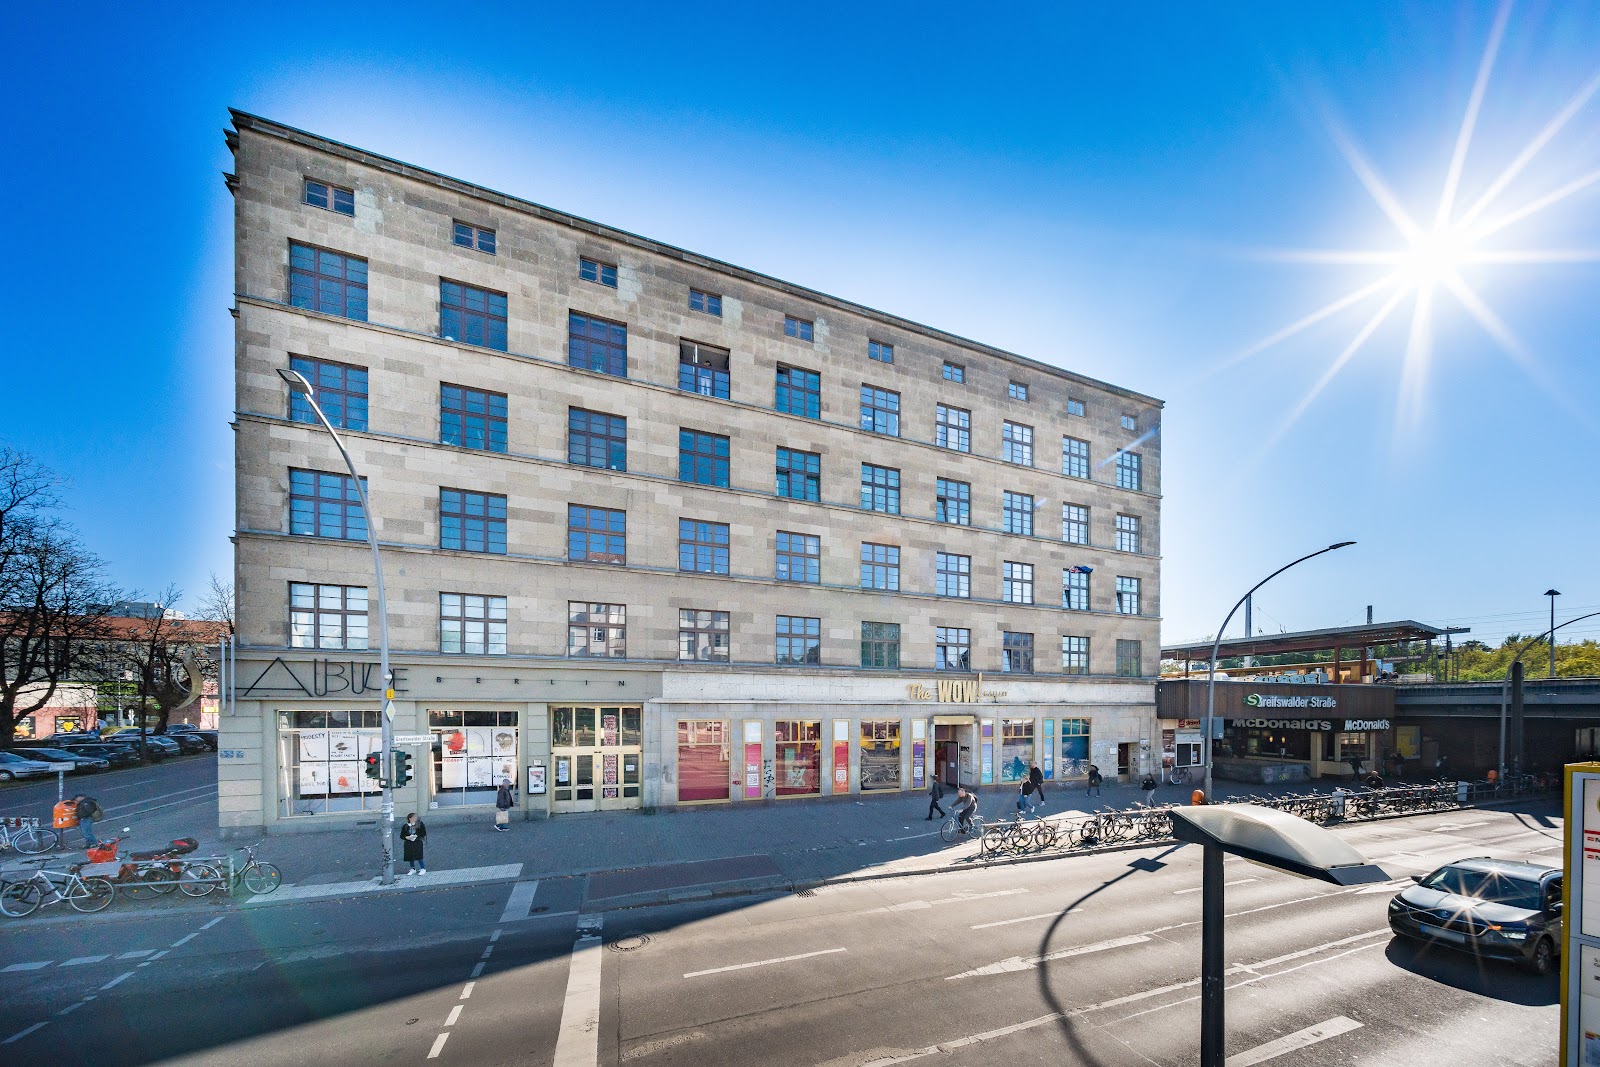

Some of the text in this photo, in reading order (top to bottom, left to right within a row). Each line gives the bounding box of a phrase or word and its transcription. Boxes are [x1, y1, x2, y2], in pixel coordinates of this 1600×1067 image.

[436, 676, 625, 687] BERLIN
[907, 683, 933, 700] The
[1311, 696, 1337, 708] Straße
[1232, 718, 1332, 731] McDonald's
[1344, 718, 1390, 731] McDonald's
